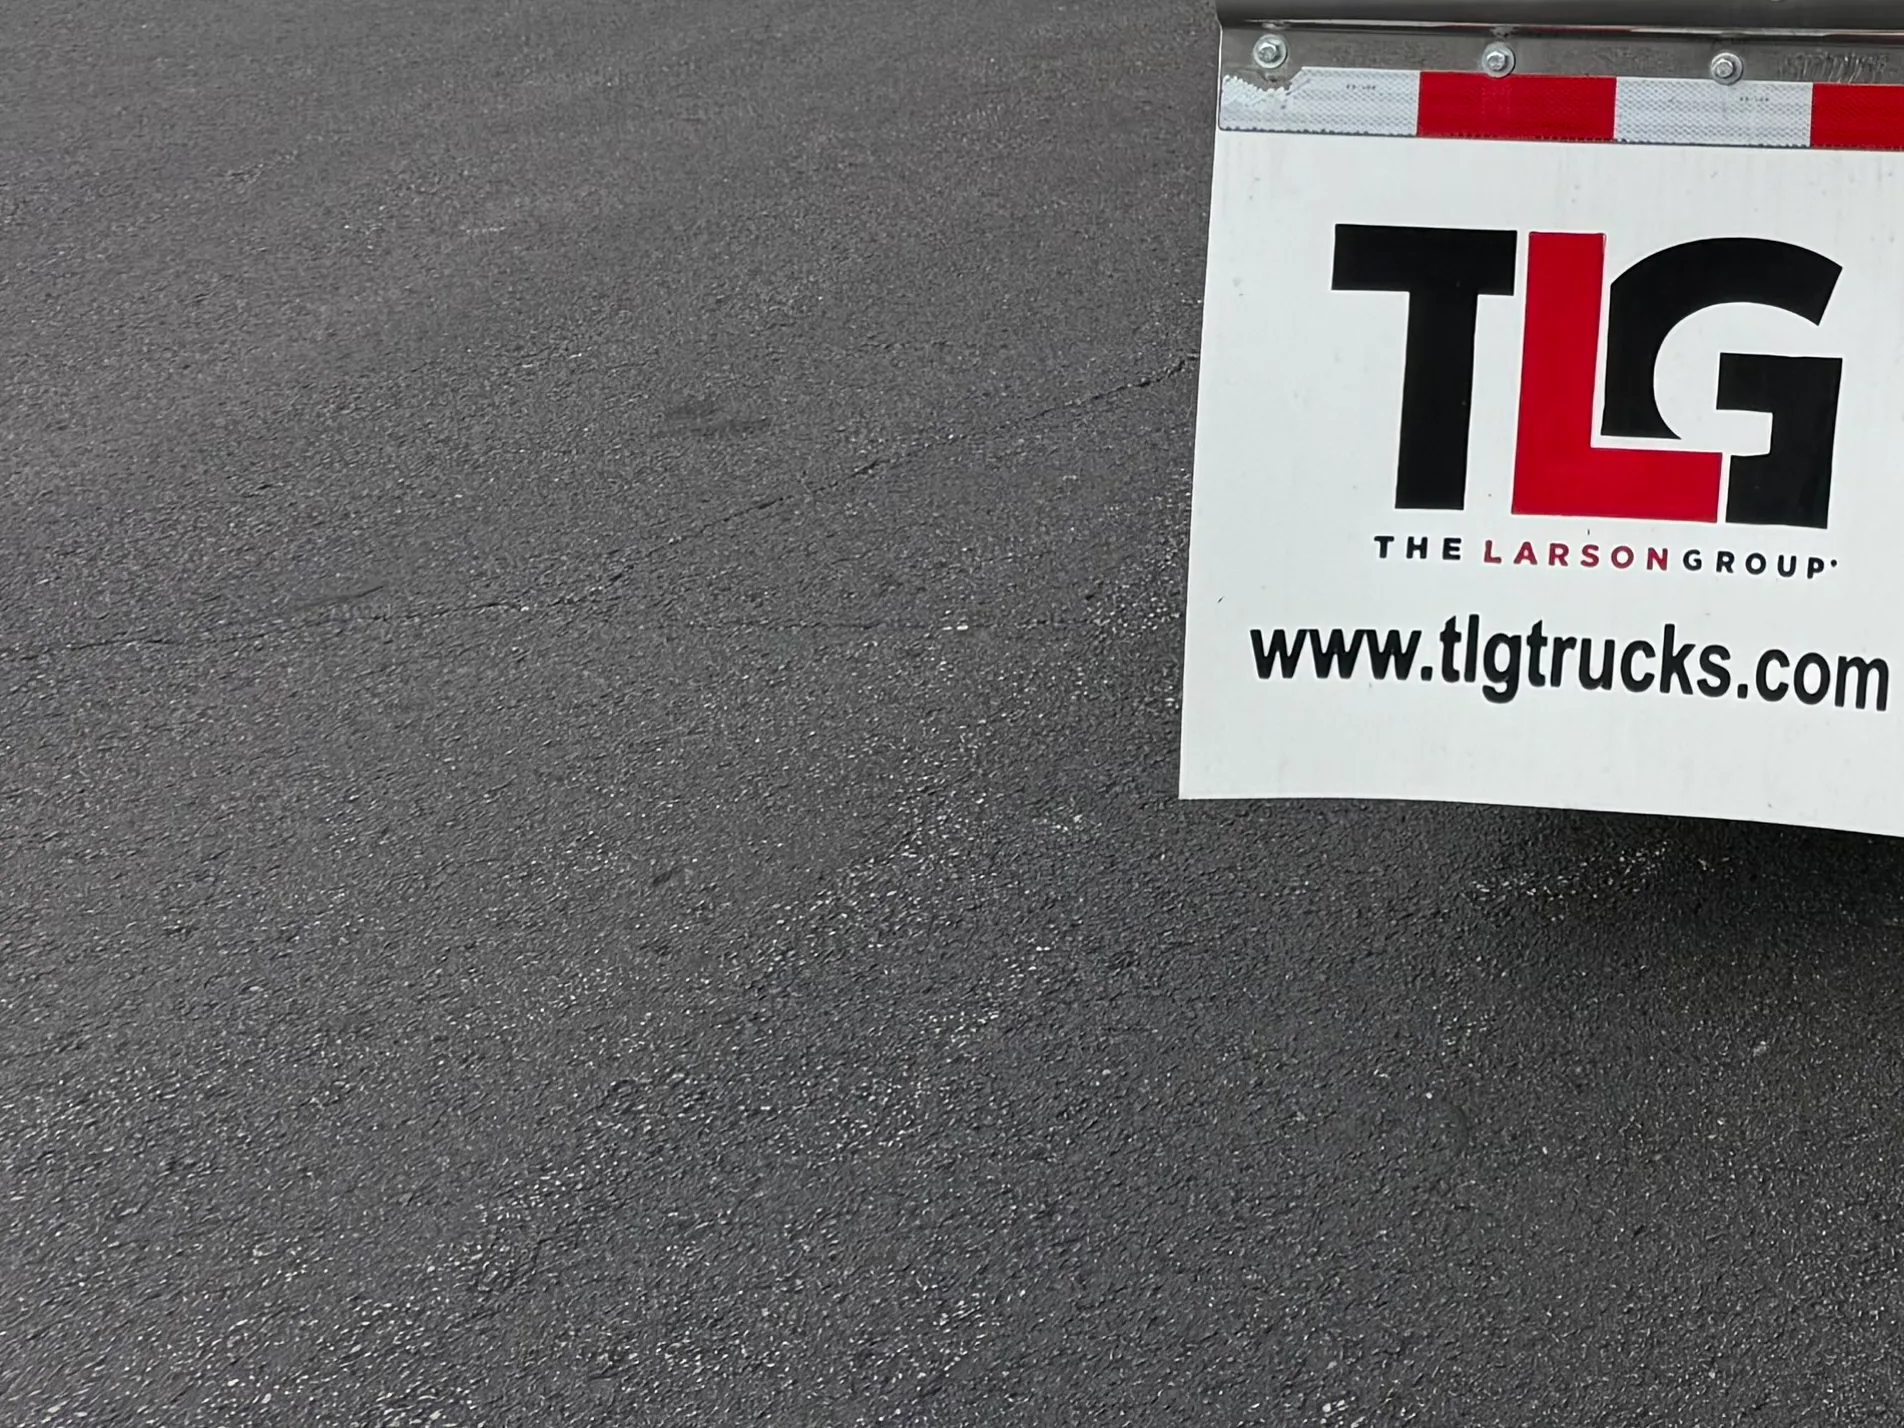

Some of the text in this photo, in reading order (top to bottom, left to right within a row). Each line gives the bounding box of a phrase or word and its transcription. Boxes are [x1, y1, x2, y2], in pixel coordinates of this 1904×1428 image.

[1331, 224, 1843, 529] TLG
[1375, 535, 1463, 562] THE
[1250, 614, 1889, 712] www.tlgtrucks.com
